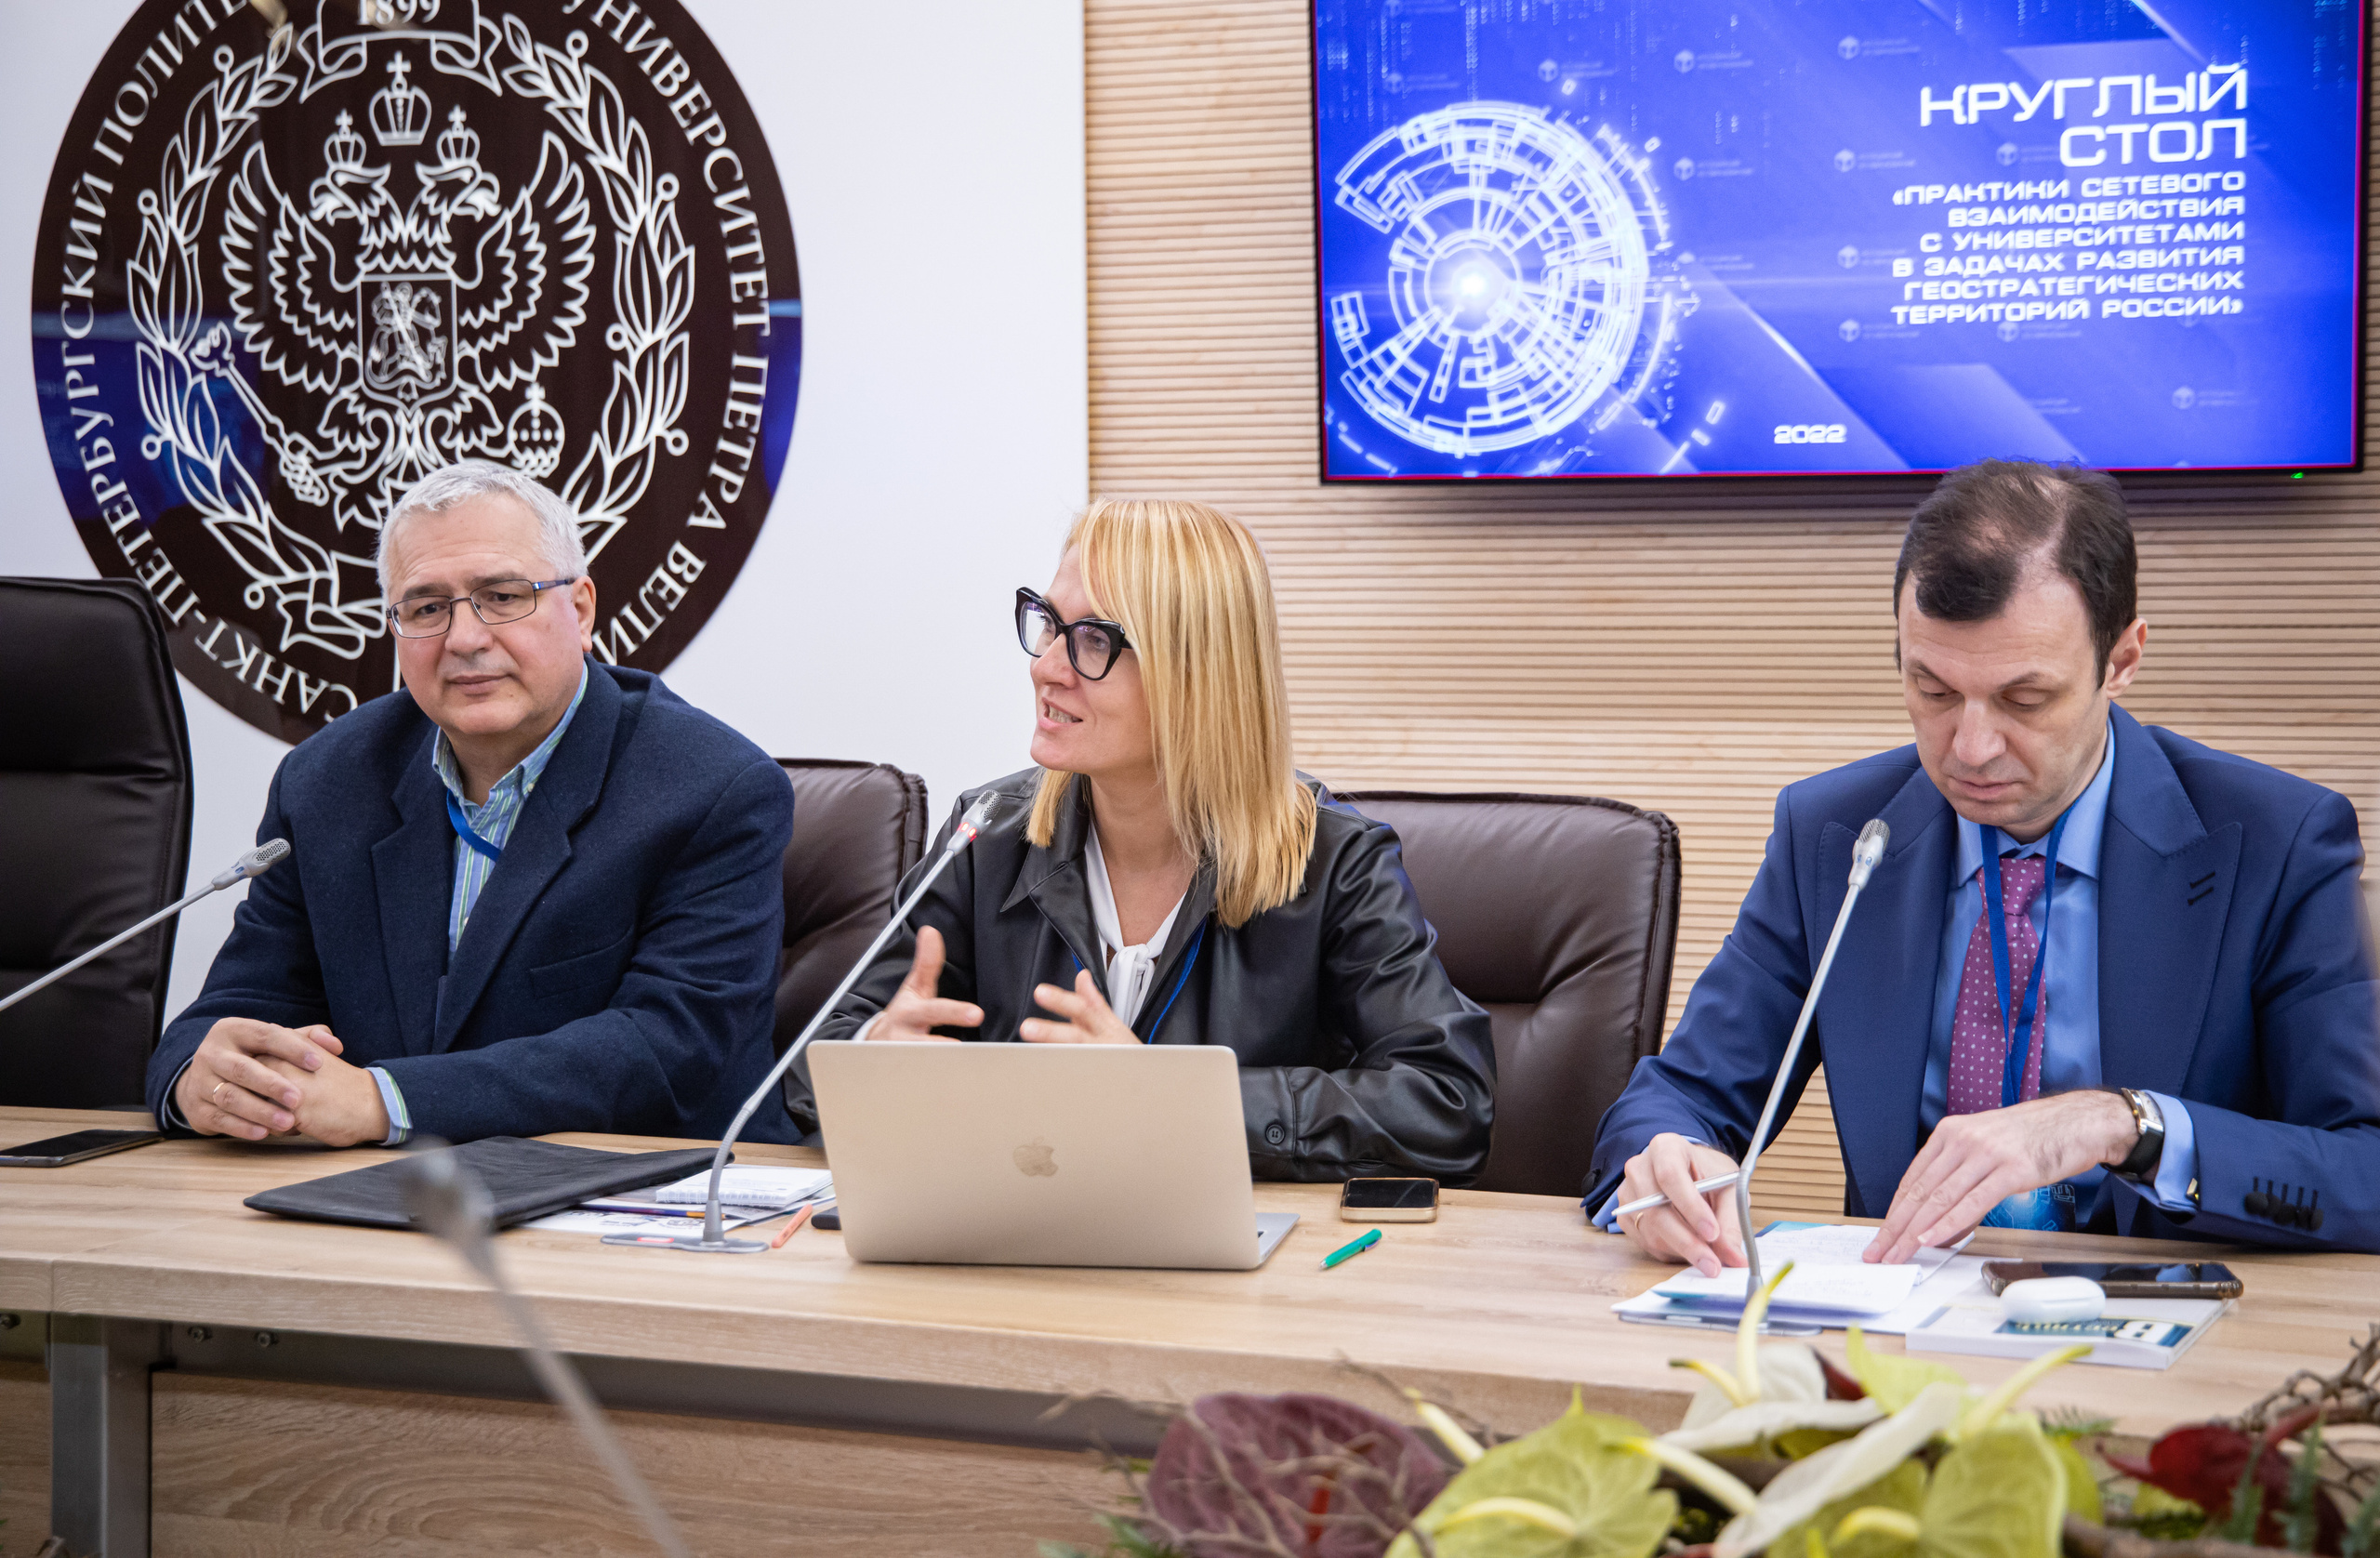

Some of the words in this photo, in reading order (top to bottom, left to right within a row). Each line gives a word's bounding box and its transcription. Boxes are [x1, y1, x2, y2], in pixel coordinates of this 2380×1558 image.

[1920, 63, 2247, 126] КРУГЛЫЙ
[2059, 118, 2247, 167] СТОЛ
[1892, 179, 2070, 205] «ПРАКТИКИ
[2081, 171, 2246, 198] СЕТЕВОГО
[1948, 196, 2245, 228] ВЗАИМОДЕЙСТВИЯ
[1920, 232, 1943, 253] С
[1952, 221, 2245, 252] УНИВЕРСИТЕТАМИ
[1893, 257, 1914, 278] В
[1924, 253, 2066, 279] ЗАДАЧАХ
[2077, 245, 2245, 271] РАЗВИТИЯ
[1904, 271, 2245, 301] ГЕОСТРАТЕГИЧЕСКИХ
[1890, 297, 2091, 325] ТЕРРИТОРИЙ
[2102, 296, 2244, 319] РОССИИ»
[61, 172, 358, 722] САНКТ-ПЕТЕРБУРГСКИЙ
[685, 354, 769, 529] ПЕТРА
[1774, 424, 1847, 444] 2022
